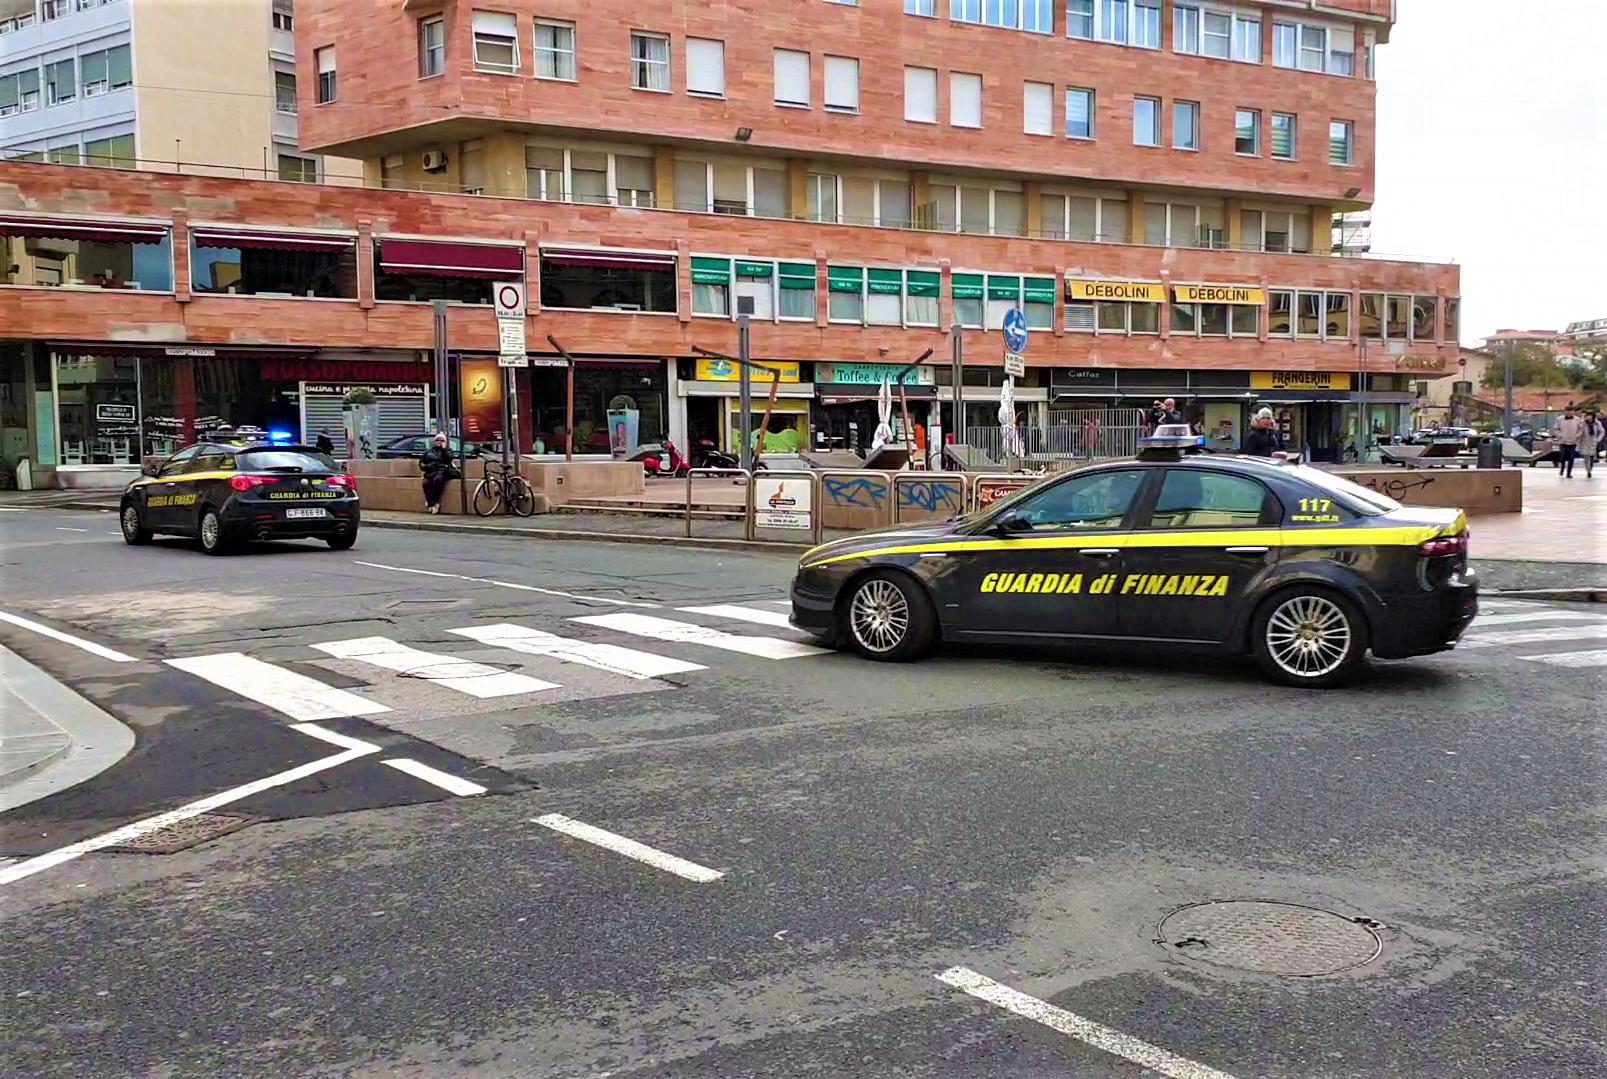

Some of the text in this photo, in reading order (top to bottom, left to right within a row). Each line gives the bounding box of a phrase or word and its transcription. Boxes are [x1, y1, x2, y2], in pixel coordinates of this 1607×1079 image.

[1085, 284, 1149, 299] DEBOLINI
[1188, 288, 1249, 301] DEBOLINI
[837, 370, 870, 382] Toffee
[873, 371, 882, 382] &
[1272, 372, 1331, 384] FRANGERINI
[378, 384, 423, 395] napoletana
[147, 494, 168, 507] GUARDIA
[175, 493, 197, 506] FINANZA
[1299, 499, 1331, 512] 117
[980, 573, 1230, 597] GUARDIA di FINANZA
